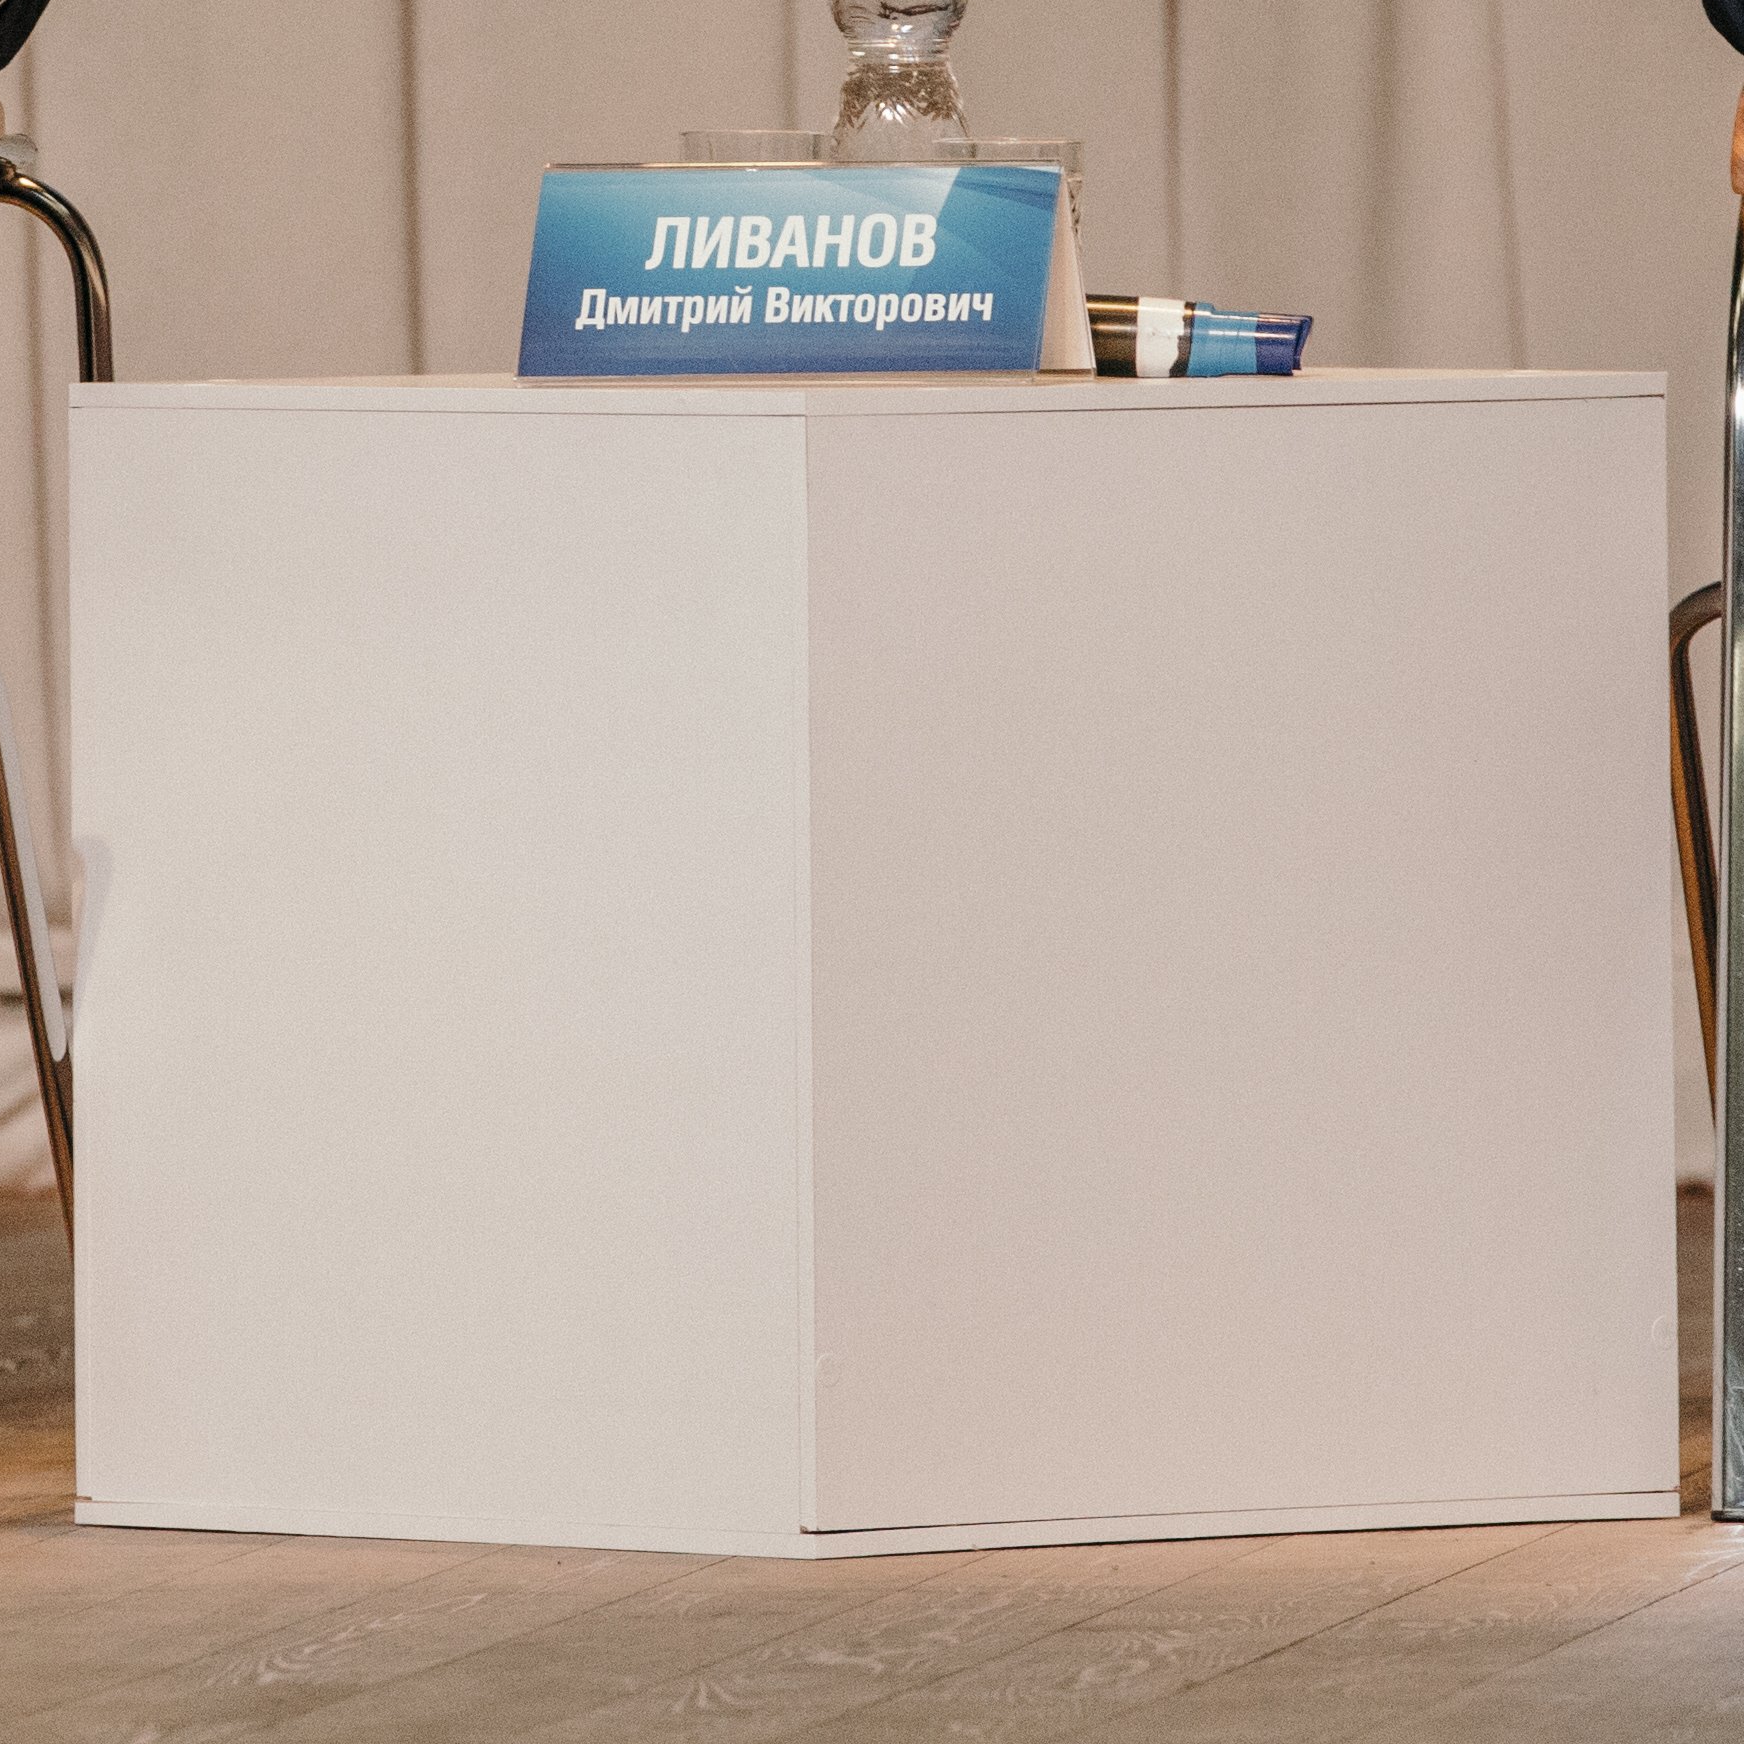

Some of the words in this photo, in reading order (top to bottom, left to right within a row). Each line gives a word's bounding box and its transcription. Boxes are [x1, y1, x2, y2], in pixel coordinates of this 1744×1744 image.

[644, 213, 938, 271] ЛИВАНОВ
[574, 284, 754, 333] Дмитрий
[764, 286, 995, 331] Викторович
